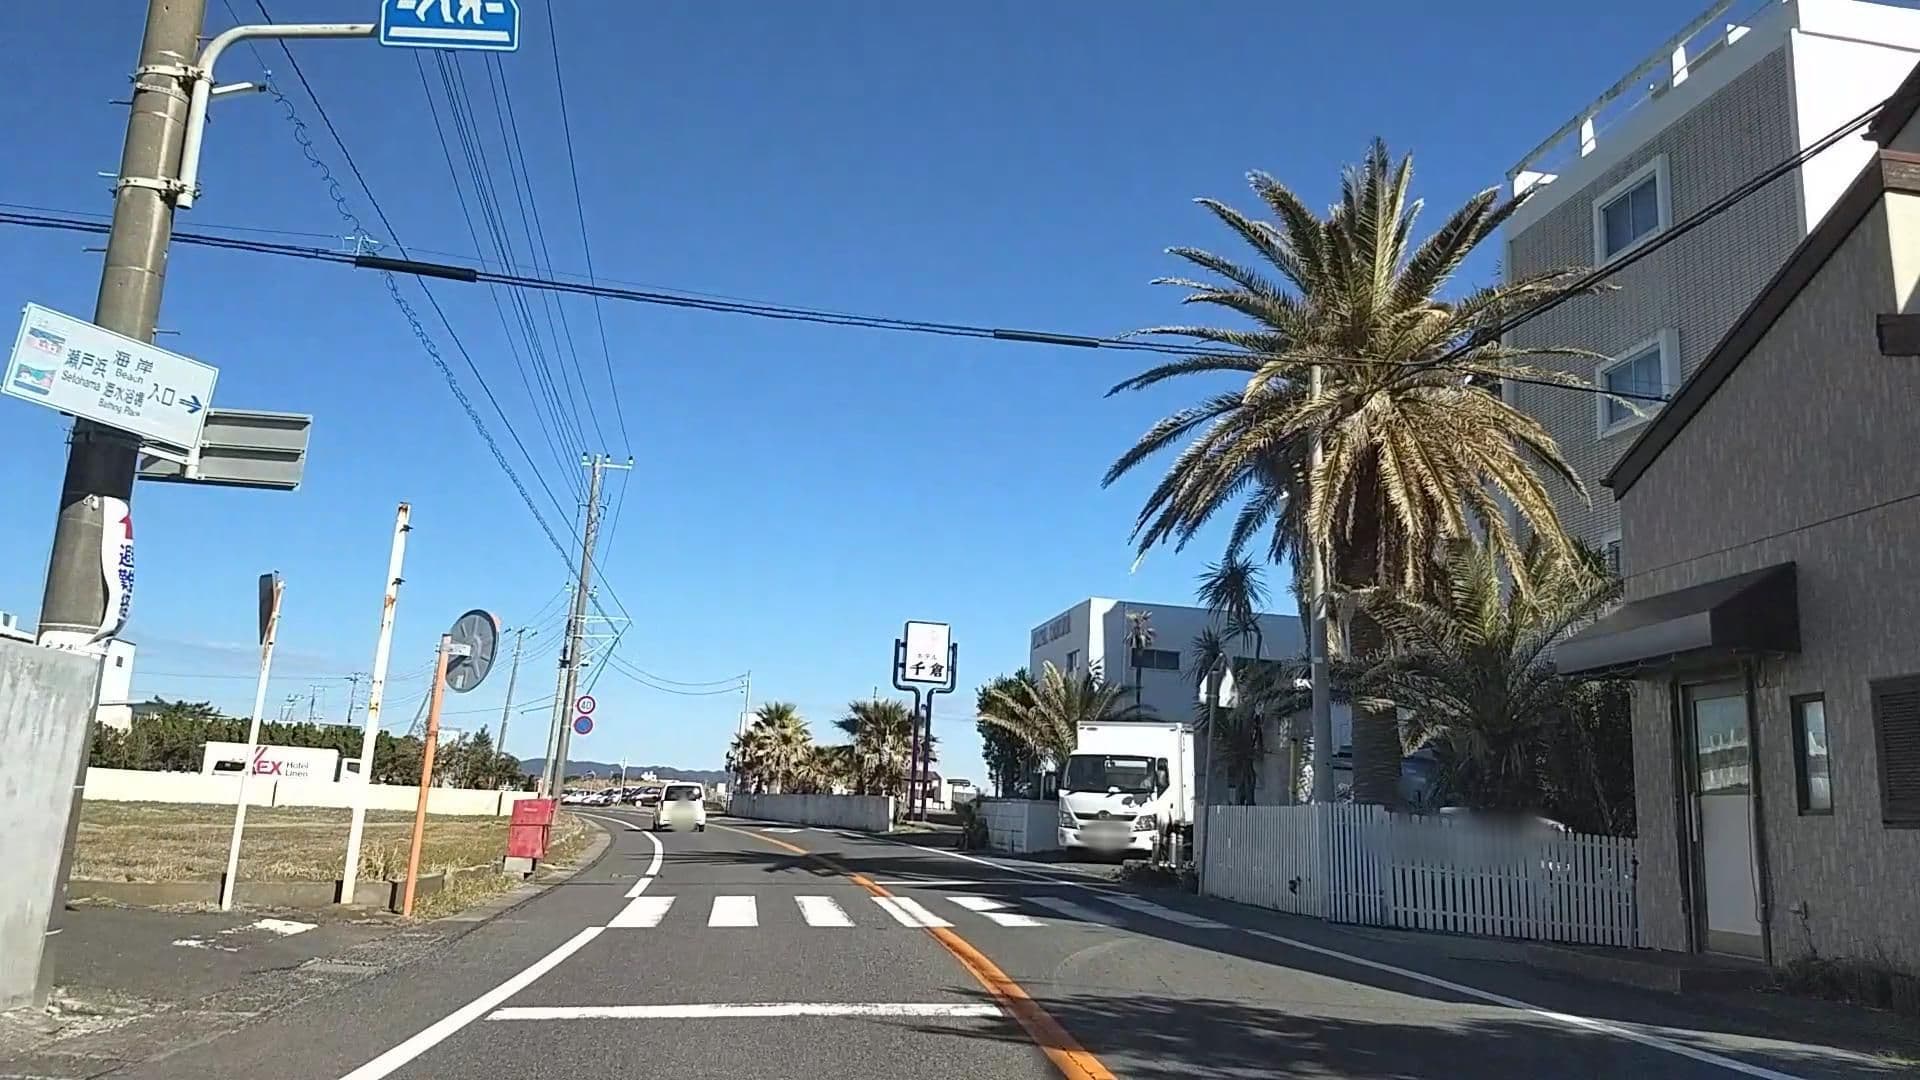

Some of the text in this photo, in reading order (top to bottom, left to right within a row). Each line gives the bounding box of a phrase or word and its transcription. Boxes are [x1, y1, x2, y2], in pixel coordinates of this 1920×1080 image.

[64, 348, 109, 379] 瀬戸浜
[61, 370, 102, 392] Setohama
[115, 368, 144, 385] Beach
[103, 381, 145, 408] 海水浴場
[147, 383, 176, 407] 入口
[98, 398, 124, 416] Bathing
[909, 661, 944, 677] 千倉
[581, 701, 591, 710] 40
